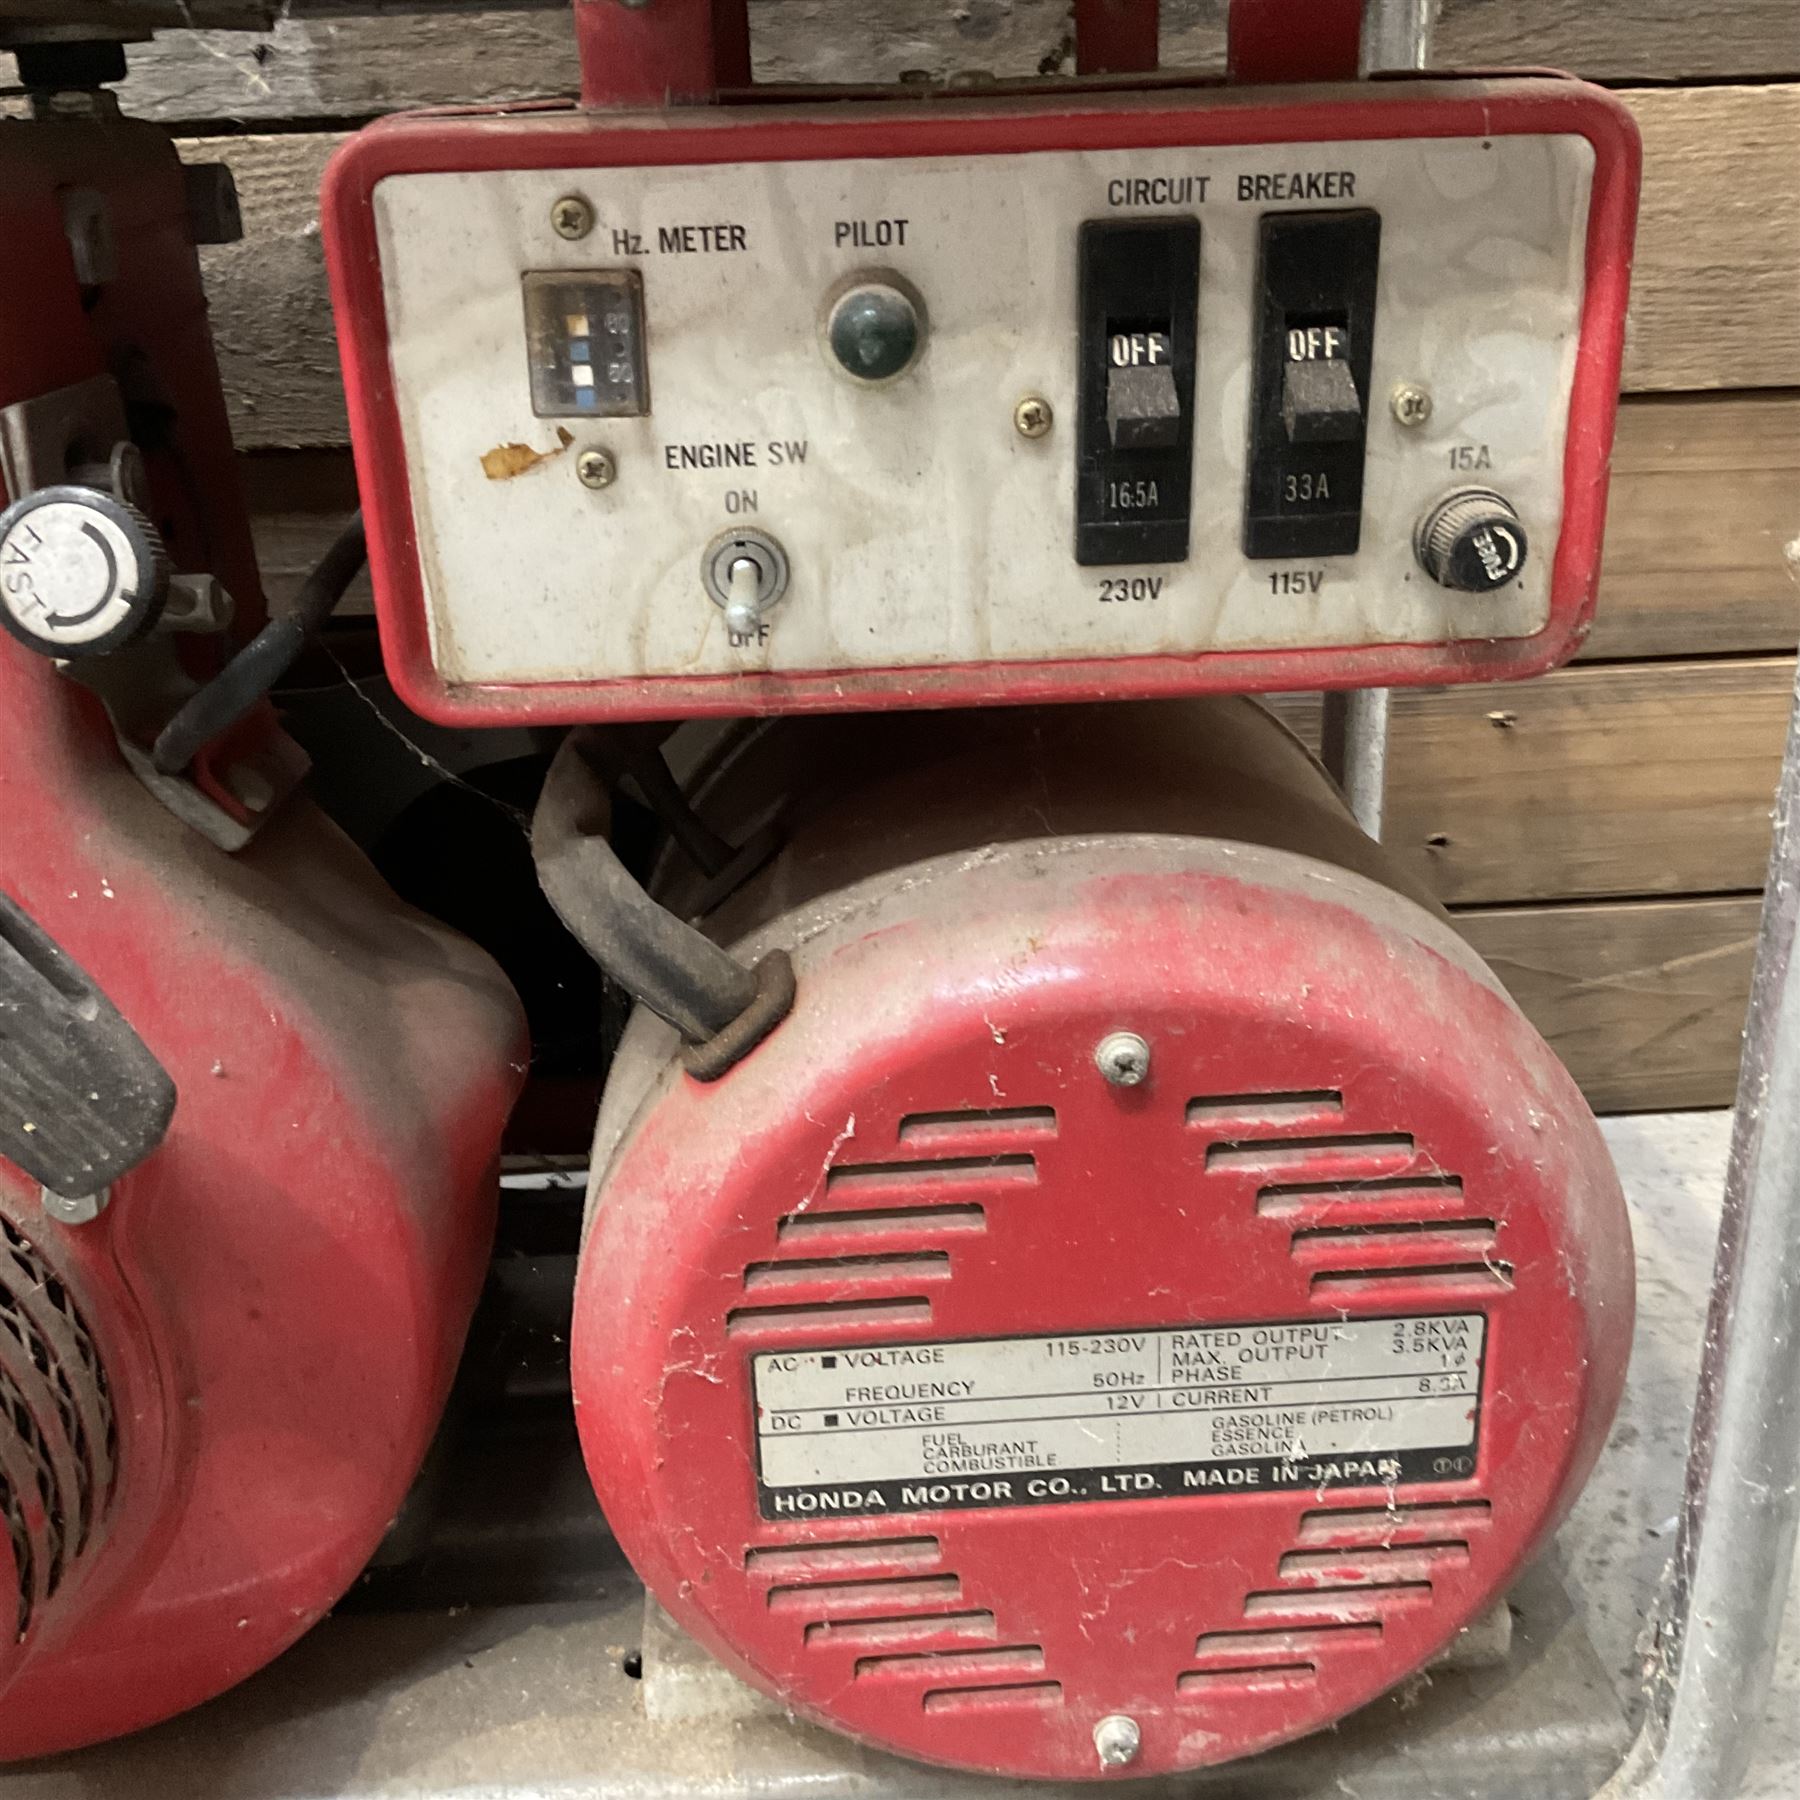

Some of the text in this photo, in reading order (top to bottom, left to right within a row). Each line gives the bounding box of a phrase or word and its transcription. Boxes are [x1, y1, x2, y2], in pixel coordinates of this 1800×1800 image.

[1108, 172, 1356, 206] CIRCUIT BREAKER
[612, 224, 746, 255] Hz. METER
[834, 219, 909, 248] PILOT
[1112, 332, 1163, 367] OFF
[1288, 327, 1339, 361] OFF
[665, 441, 808, 469] ENGINE SW
[1449, 445, 1491, 470] 15A
[725, 490, 758, 513] ON
[1472, 527, 1507, 581] FUSE
[3, 523, 47, 617] FAST
[1099, 577, 1163, 602] 230V
[1268, 571, 1324, 595] 115V
[1172, 1326, 1343, 1349] RATED OUTPUT
[1394, 1319, 1469, 1337] 2.8KVA
[768, 1337, 1146, 1373] AC VOLTAGE 115-230V
[1172, 1344, 1329, 1366] MAX. OUTPUT
[1393, 1336, 1468, 1354] 3.5KVA
[1172, 1365, 1243, 1383] PHASE
[846, 1372, 1145, 1402] FREQUENCY 50Hz
[1172, 1387, 1272, 1406] CURRENT
[771, 1394, 1145, 1430] DC VOLTAGE 12V
[1211, 1406, 1392, 1430] GASOLINE (PETROL)
[922, 1433, 966, 1447] FUEL
[1211, 1426, 1294, 1443] ESSENCE
[922, 1440, 1038, 1460] CARBURANT
[923, 1453, 1057, 1474] COMBUSTIBLE
[774, 1490, 886, 1513] HONDA
[901, 1481, 1013, 1505] MOTOR
[1101, 1472, 1162, 1493] LTD.
[1184, 1469, 1260, 1487] MADE
[1273, 1465, 1298, 1482] IN
